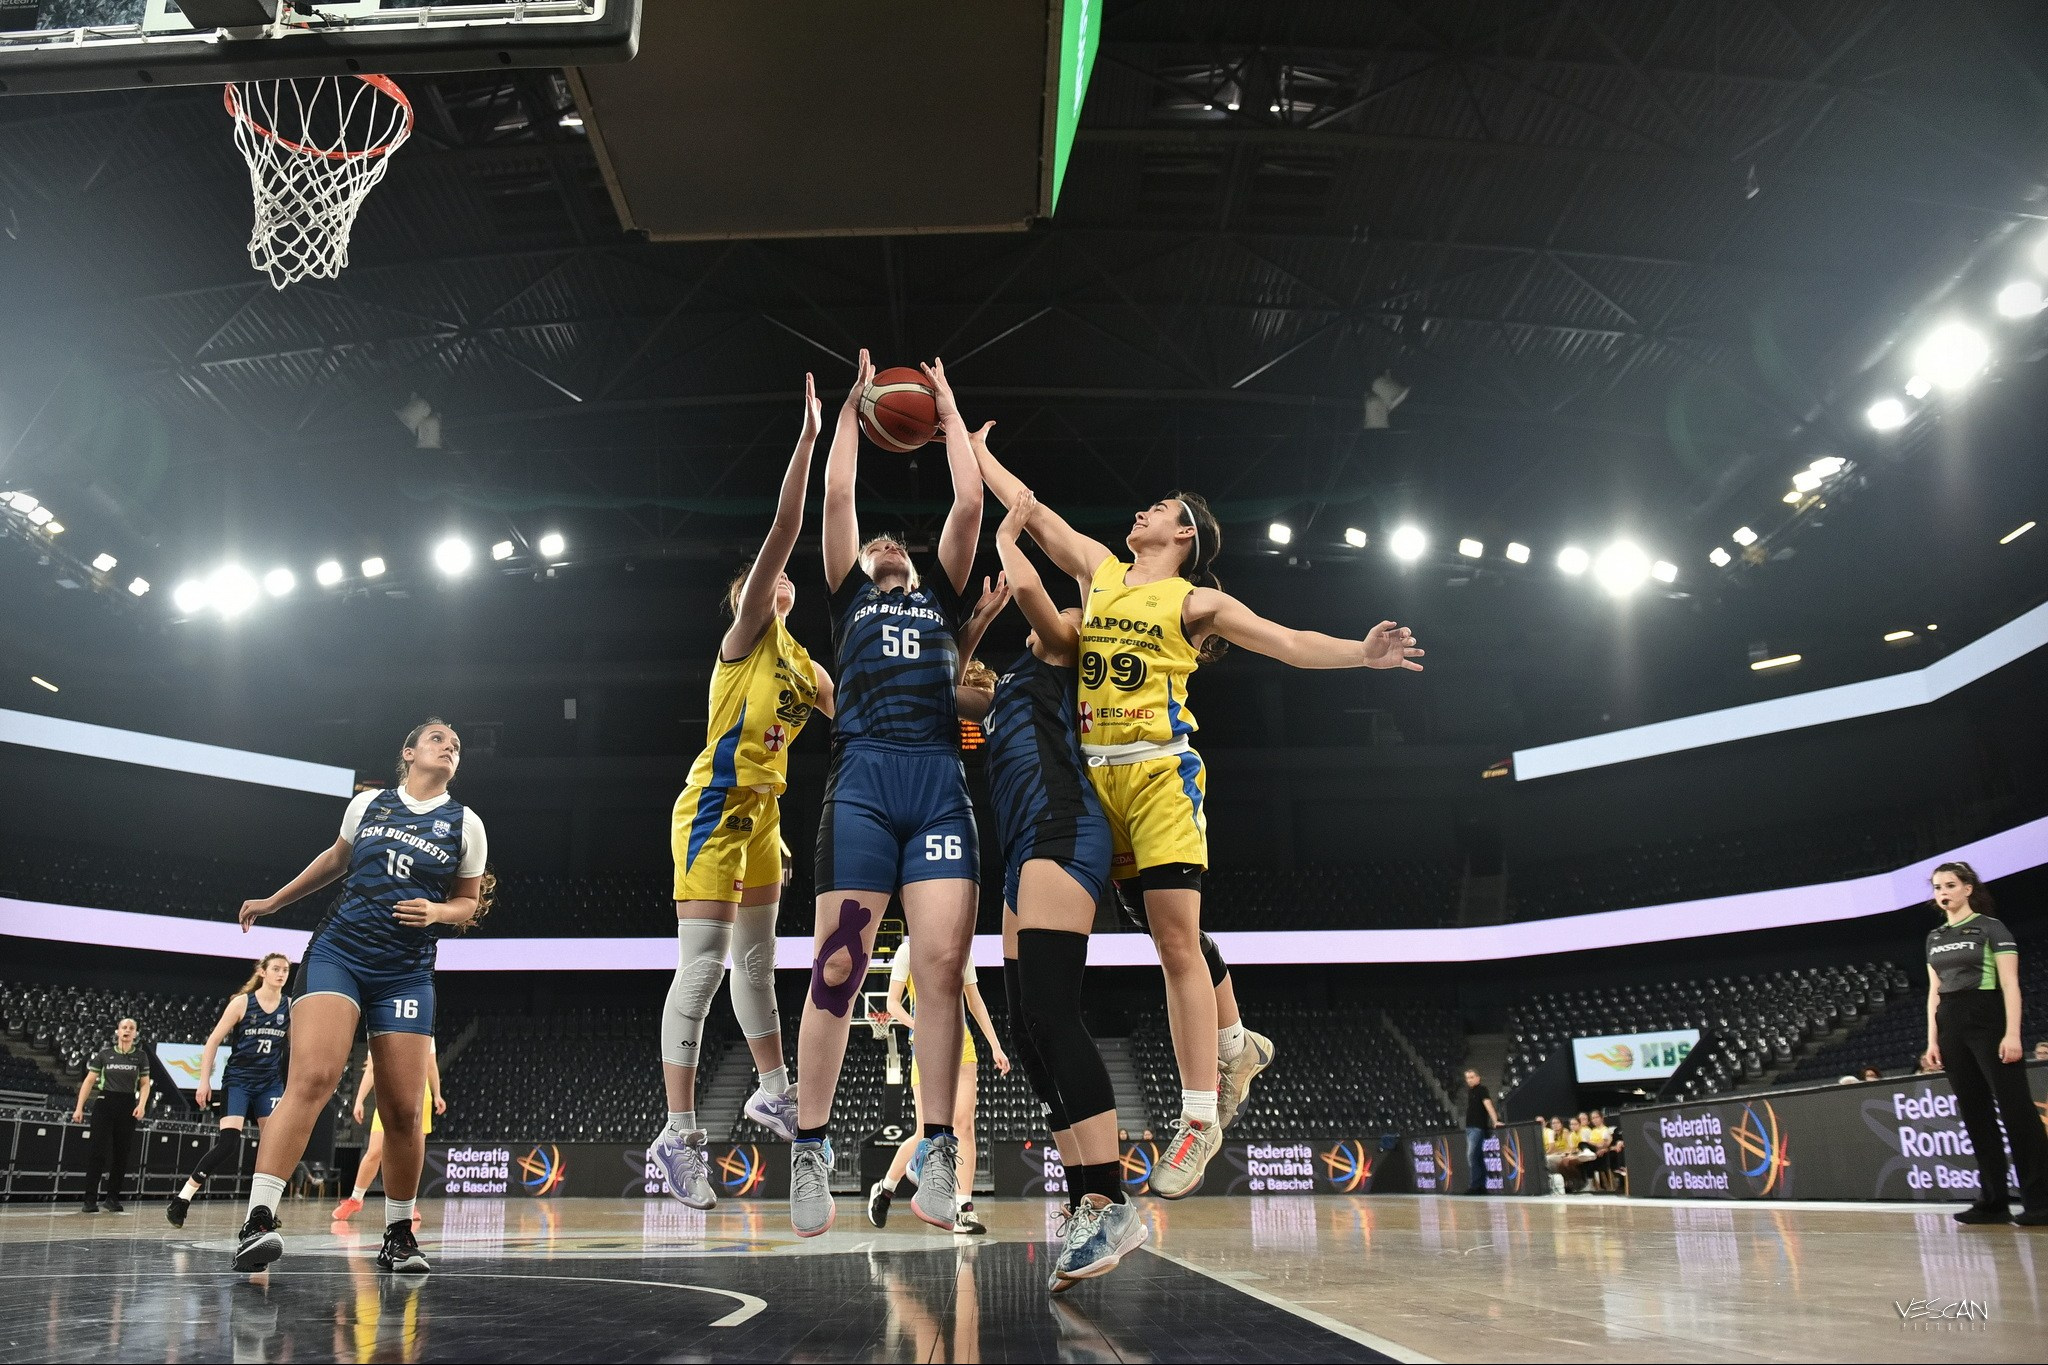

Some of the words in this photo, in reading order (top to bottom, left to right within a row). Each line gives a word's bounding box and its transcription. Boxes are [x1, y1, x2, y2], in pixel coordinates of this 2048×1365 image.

[855, 604, 878, 622] CSM
[882, 624, 920, 659] 56
[1120, 638, 1161, 652] SCHOOL
[1081, 651, 1147, 692] 99
[725, 815, 754, 832] 22
[361, 826, 384, 838] CSM
[385, 828, 450, 864] BUCURESTI
[925, 834, 962, 861] 56
[386, 848, 414, 879] 16
[393, 999, 419, 1019] 16
[256, 1039, 272, 1054] 73
[1663, 1138, 1726, 1166] Română
[446, 1162, 509, 1179] Română
[1247, 1159, 1313, 1176] Română
[1907, 1164, 1933, 1189] de
[445, 1180, 460, 1193] de
[462, 1180, 507, 1193] Baschet
[644, 1181, 660, 1193] de
[1044, 1180, 1060, 1192] de
[1249, 1177, 1265, 1190] de
[1267, 1177, 1314, 1190] Baschet
[1668, 1171, 1683, 1189] de
[1684, 1169, 1729, 1190] Baschet
